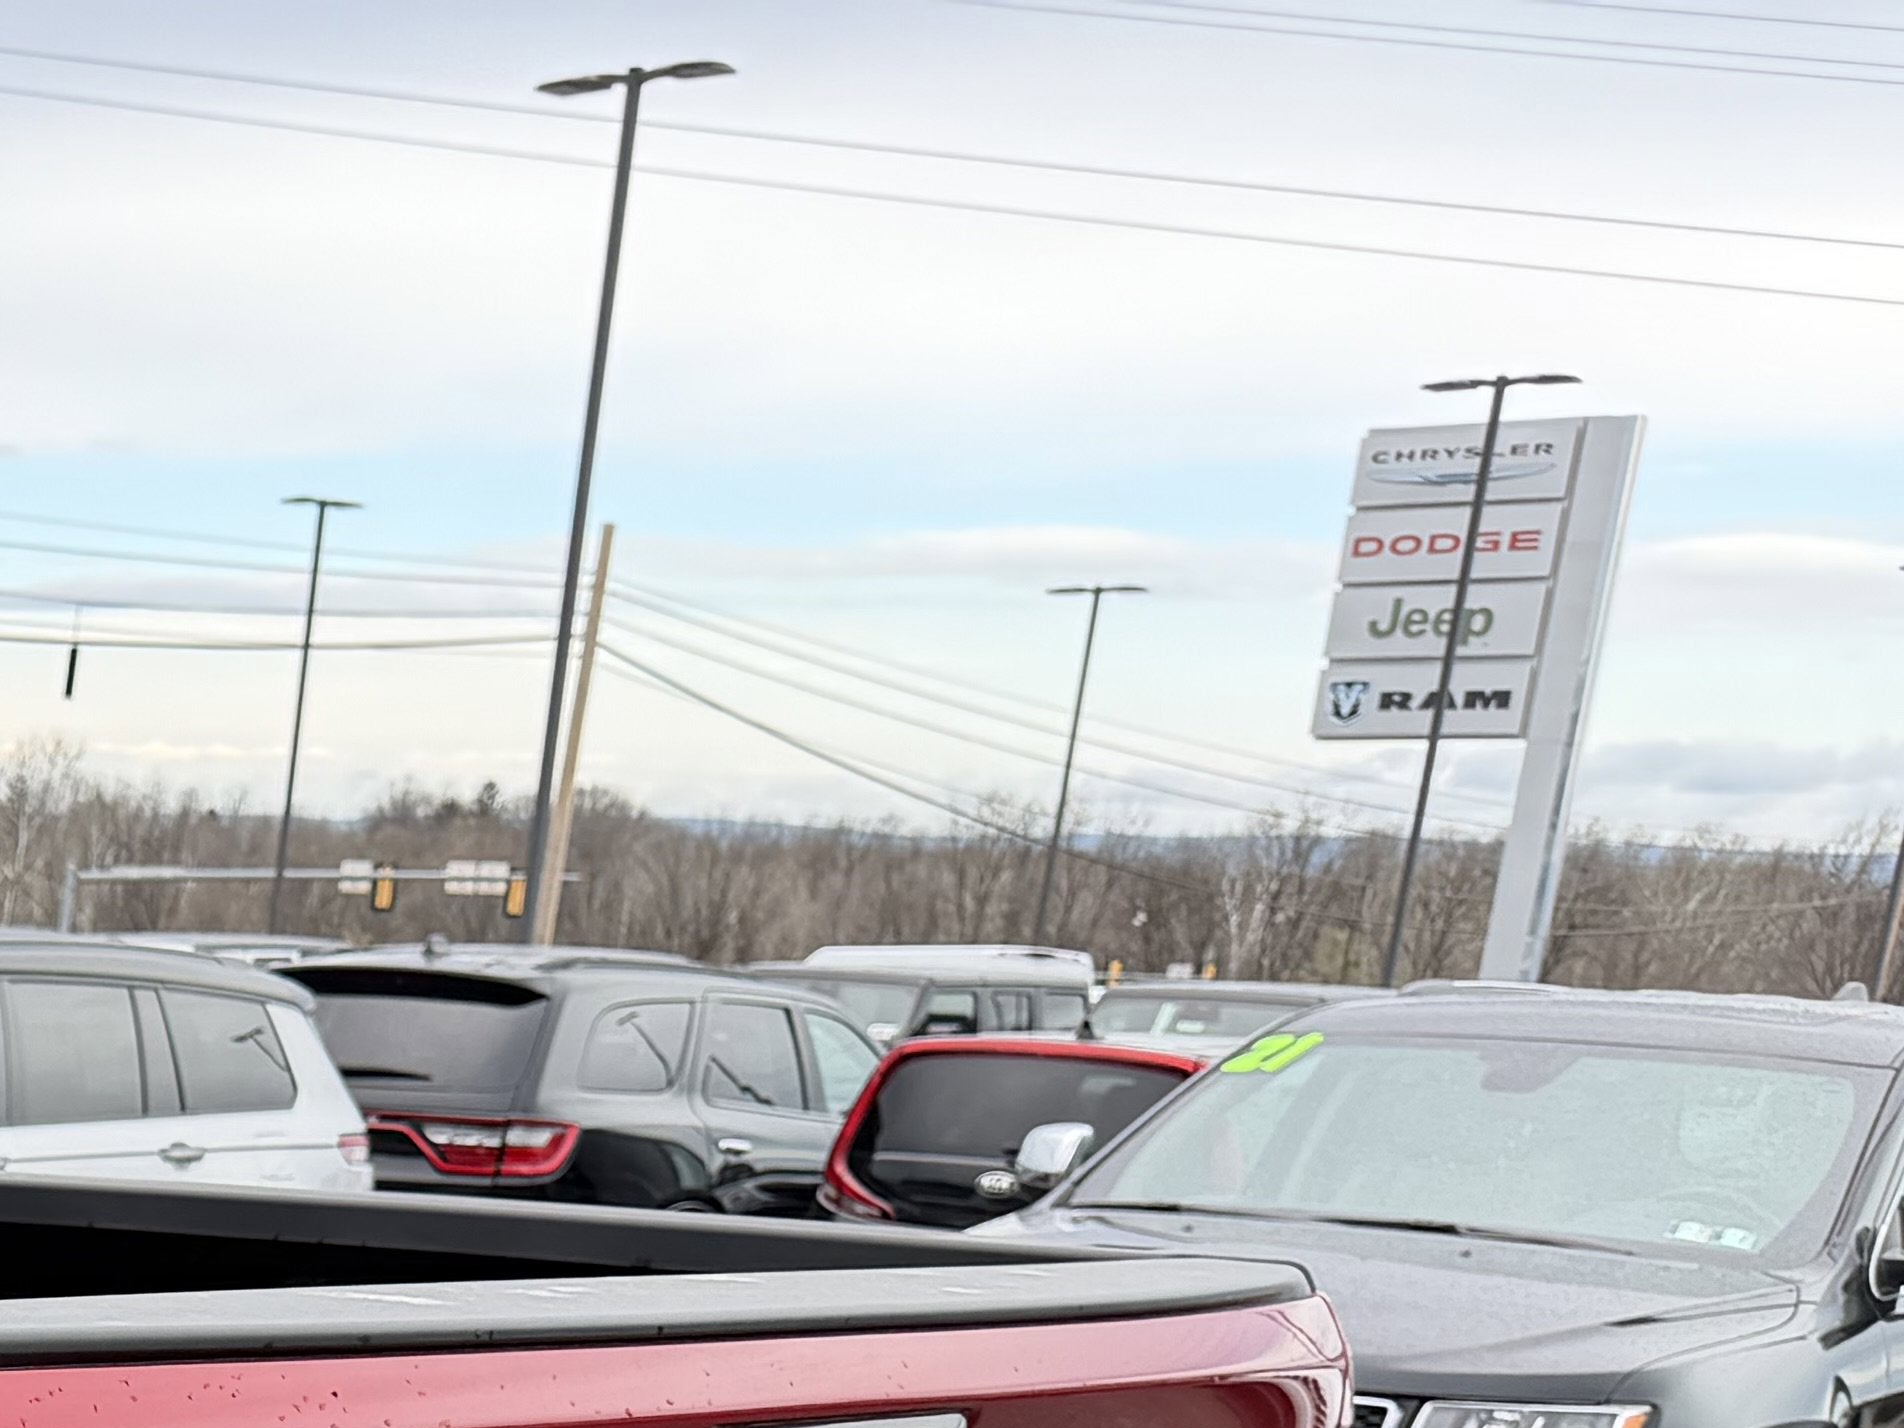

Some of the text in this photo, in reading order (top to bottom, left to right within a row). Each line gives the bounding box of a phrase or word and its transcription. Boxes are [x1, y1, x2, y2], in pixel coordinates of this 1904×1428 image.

[1352, 529, 1543, 558] DODGE
[1368, 597, 1495, 647] Jeep
[1378, 690, 1512, 711] RAM
